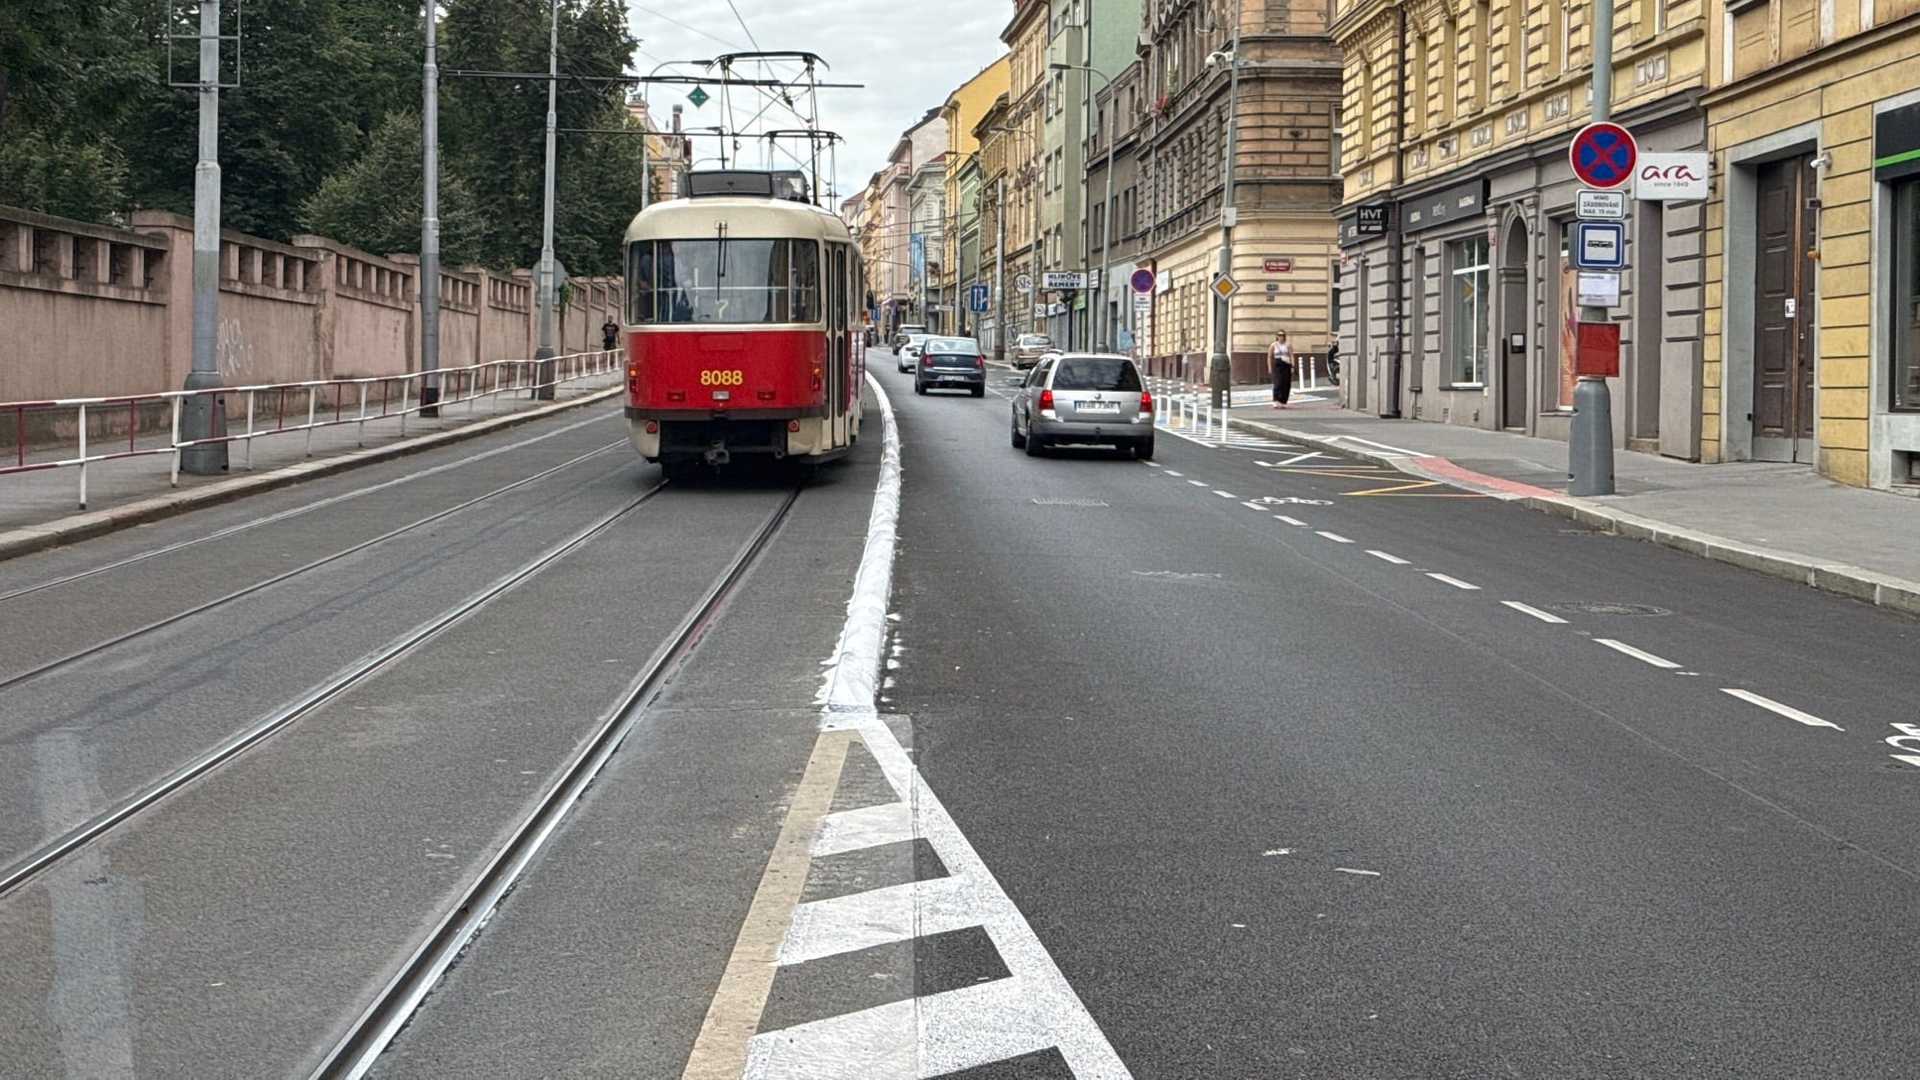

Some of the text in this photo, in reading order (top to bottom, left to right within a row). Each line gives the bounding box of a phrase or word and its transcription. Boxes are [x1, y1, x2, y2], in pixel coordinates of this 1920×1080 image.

[1641, 165, 1702, 181] ara
[1360, 208, 1383, 219] HVT
[716, 300, 729, 320] 7
[700, 370, 743, 385] 8088
